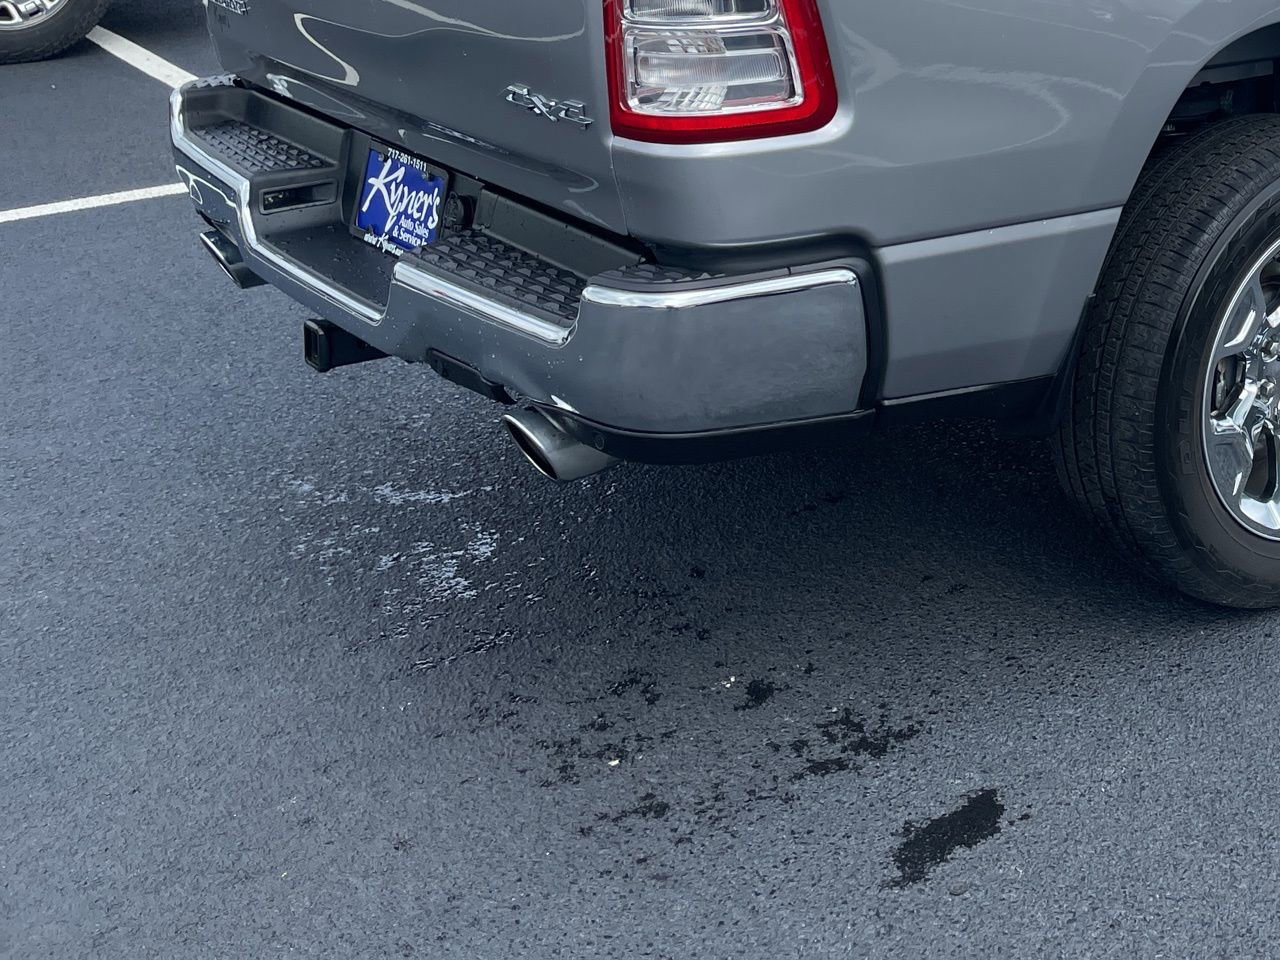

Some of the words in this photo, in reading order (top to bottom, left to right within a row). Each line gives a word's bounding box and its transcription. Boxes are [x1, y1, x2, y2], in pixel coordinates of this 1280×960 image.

[387, 147, 428, 172] 717-261-1511
[361, 158, 441, 233] Kyner's
[392, 224, 400, 238] &
[399, 227, 421, 247] Service
[398, 214, 415, 231] Auto
[413, 220, 430, 239] Sales
